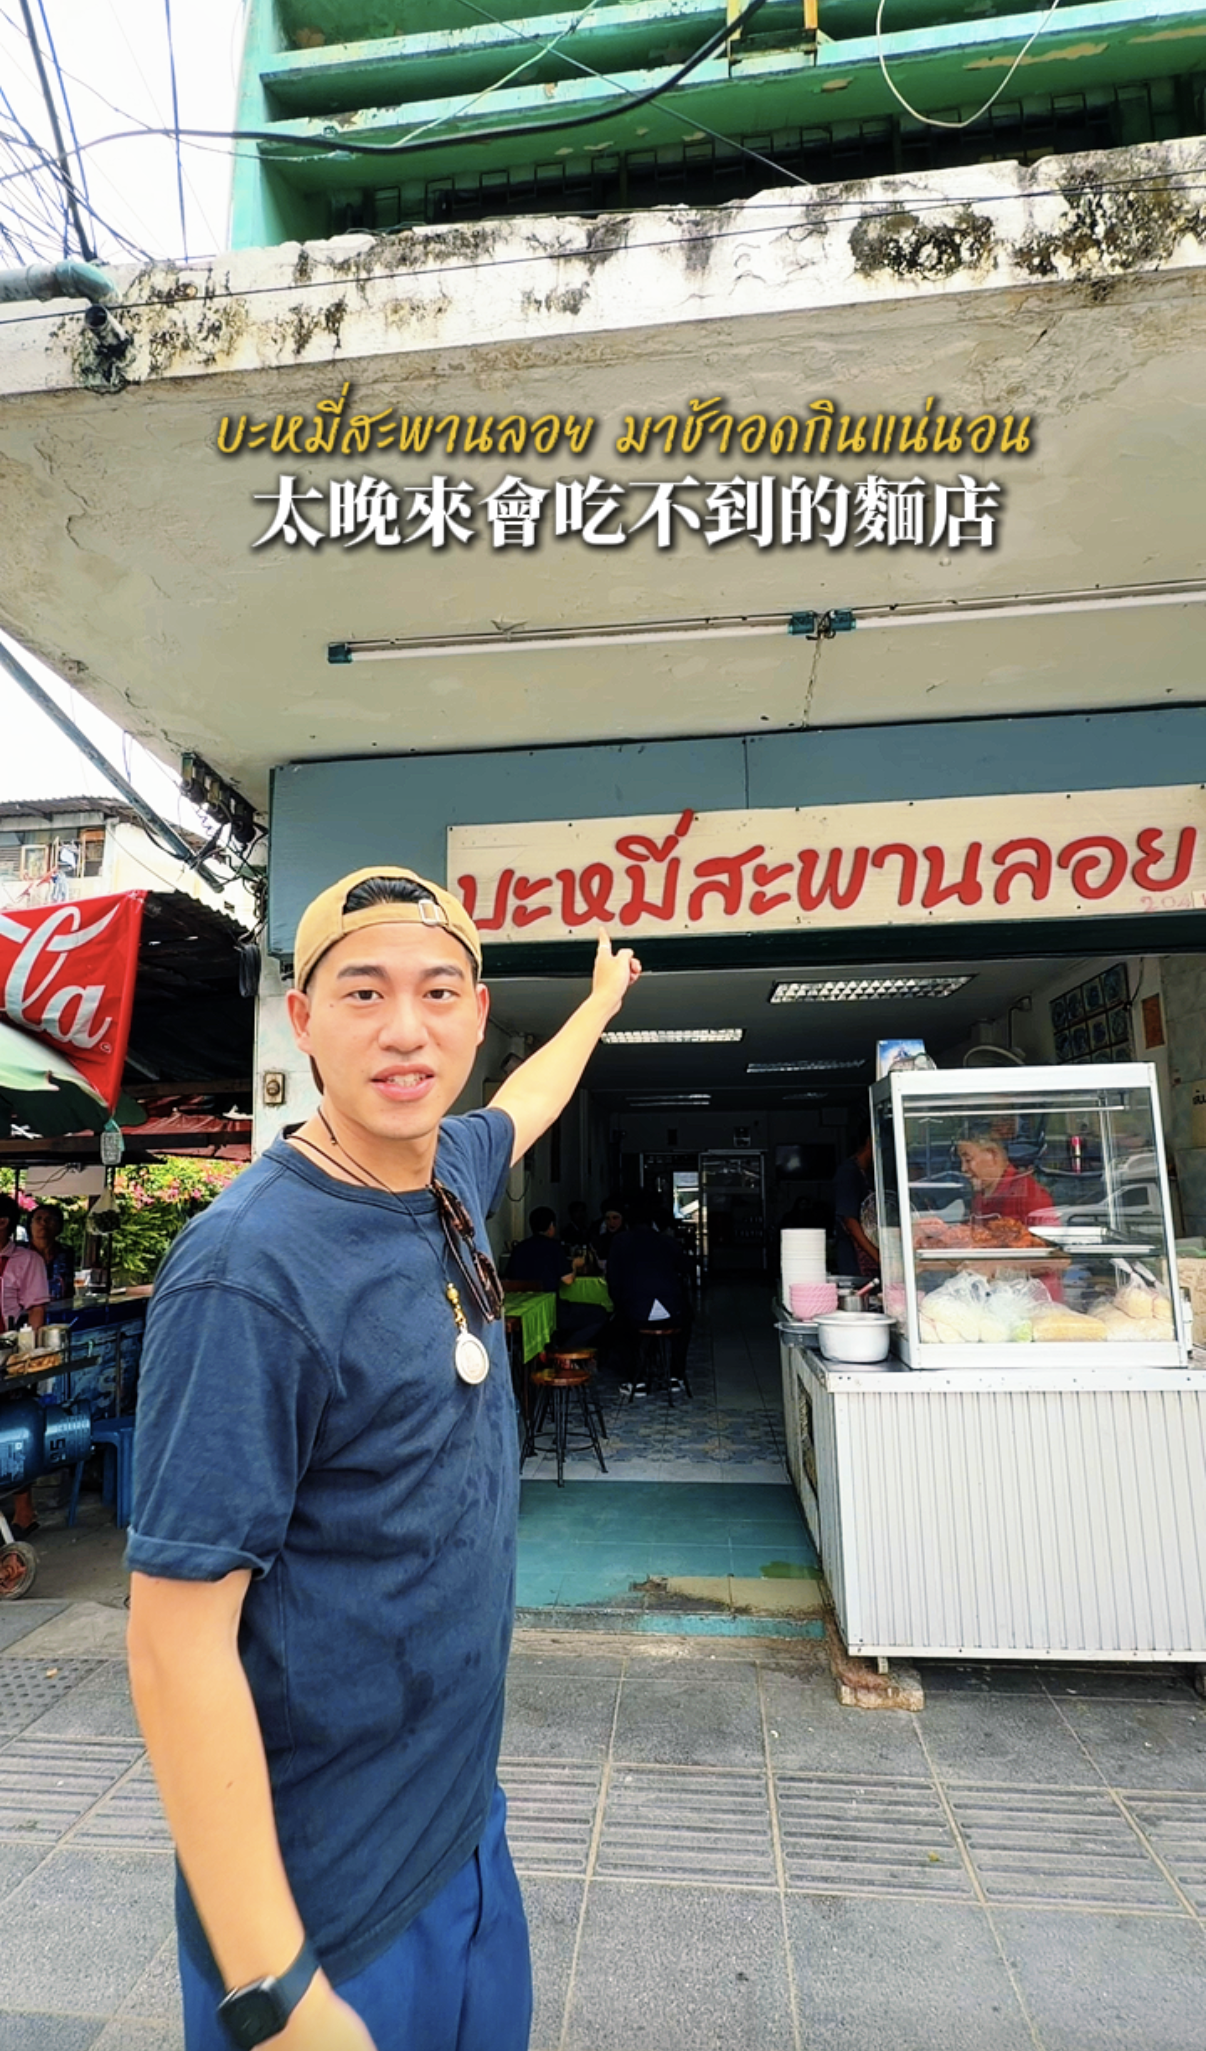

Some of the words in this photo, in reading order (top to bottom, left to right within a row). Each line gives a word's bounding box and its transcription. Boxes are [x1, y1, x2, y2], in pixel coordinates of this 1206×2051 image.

[457, 808, 1197, 930] บะหมี่สะพานลอย
